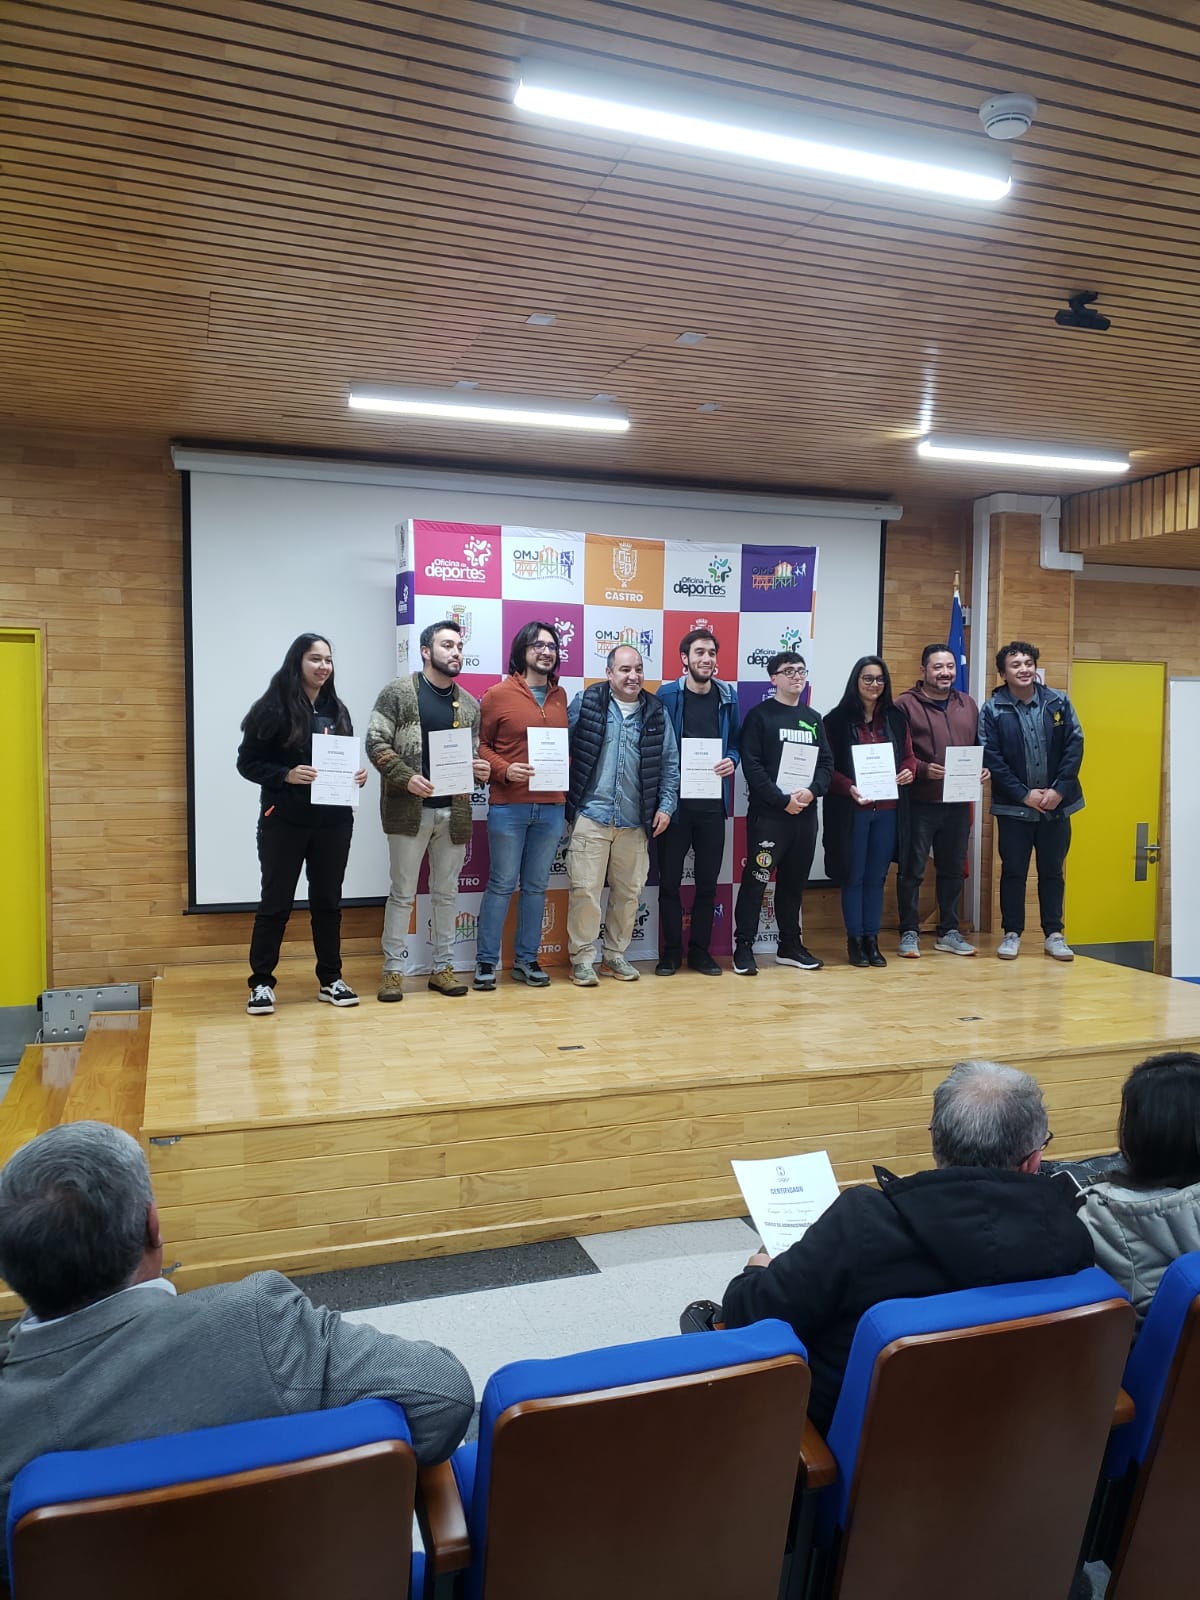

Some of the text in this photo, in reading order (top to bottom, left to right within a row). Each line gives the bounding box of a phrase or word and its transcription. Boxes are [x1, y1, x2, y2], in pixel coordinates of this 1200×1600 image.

[513, 550, 539, 561] OMJ
[433, 558, 460, 567] Oficina
[424, 562, 487, 581] deportes
[673, 580, 727, 597] deportes
[604, 591, 644, 602] CASTRO
[595, 630, 620, 641] OMJ
[779, 728, 813, 744] PUMA
